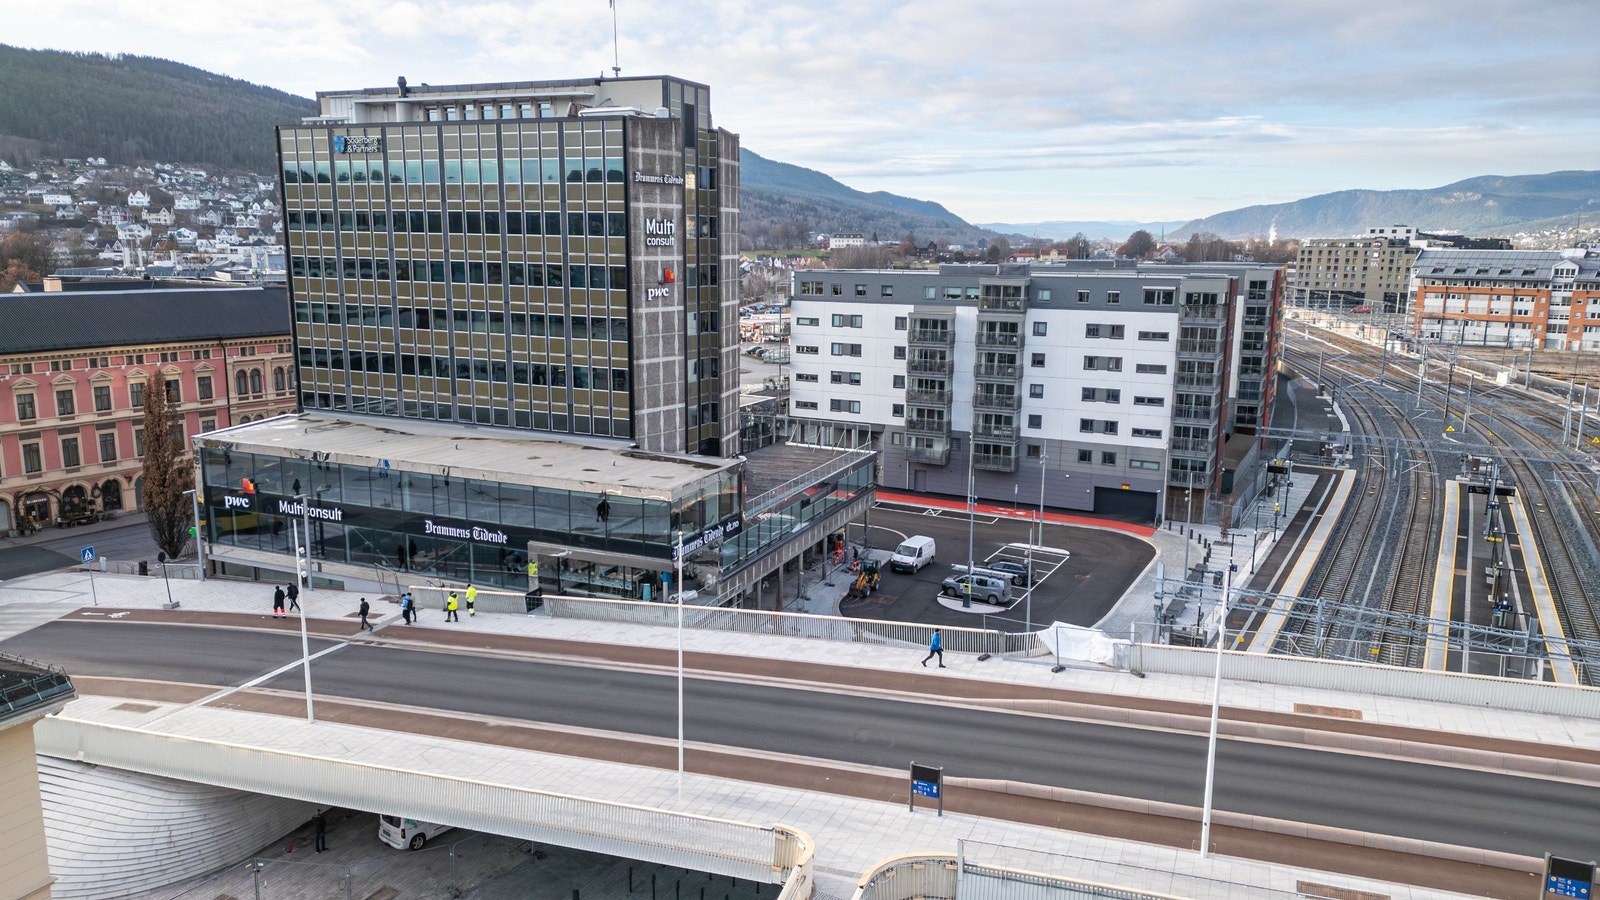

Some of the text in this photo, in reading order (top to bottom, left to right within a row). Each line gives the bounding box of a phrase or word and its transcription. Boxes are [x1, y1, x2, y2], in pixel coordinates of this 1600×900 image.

[634, 171, 684, 185] Drammens Tidende
[646, 218, 675, 235] Multi
[646, 236, 675, 246] consult
[647, 287, 669, 300] pwc
[224, 495, 250, 508] pwc
[425, 520, 508, 544] Drammens Tidende
